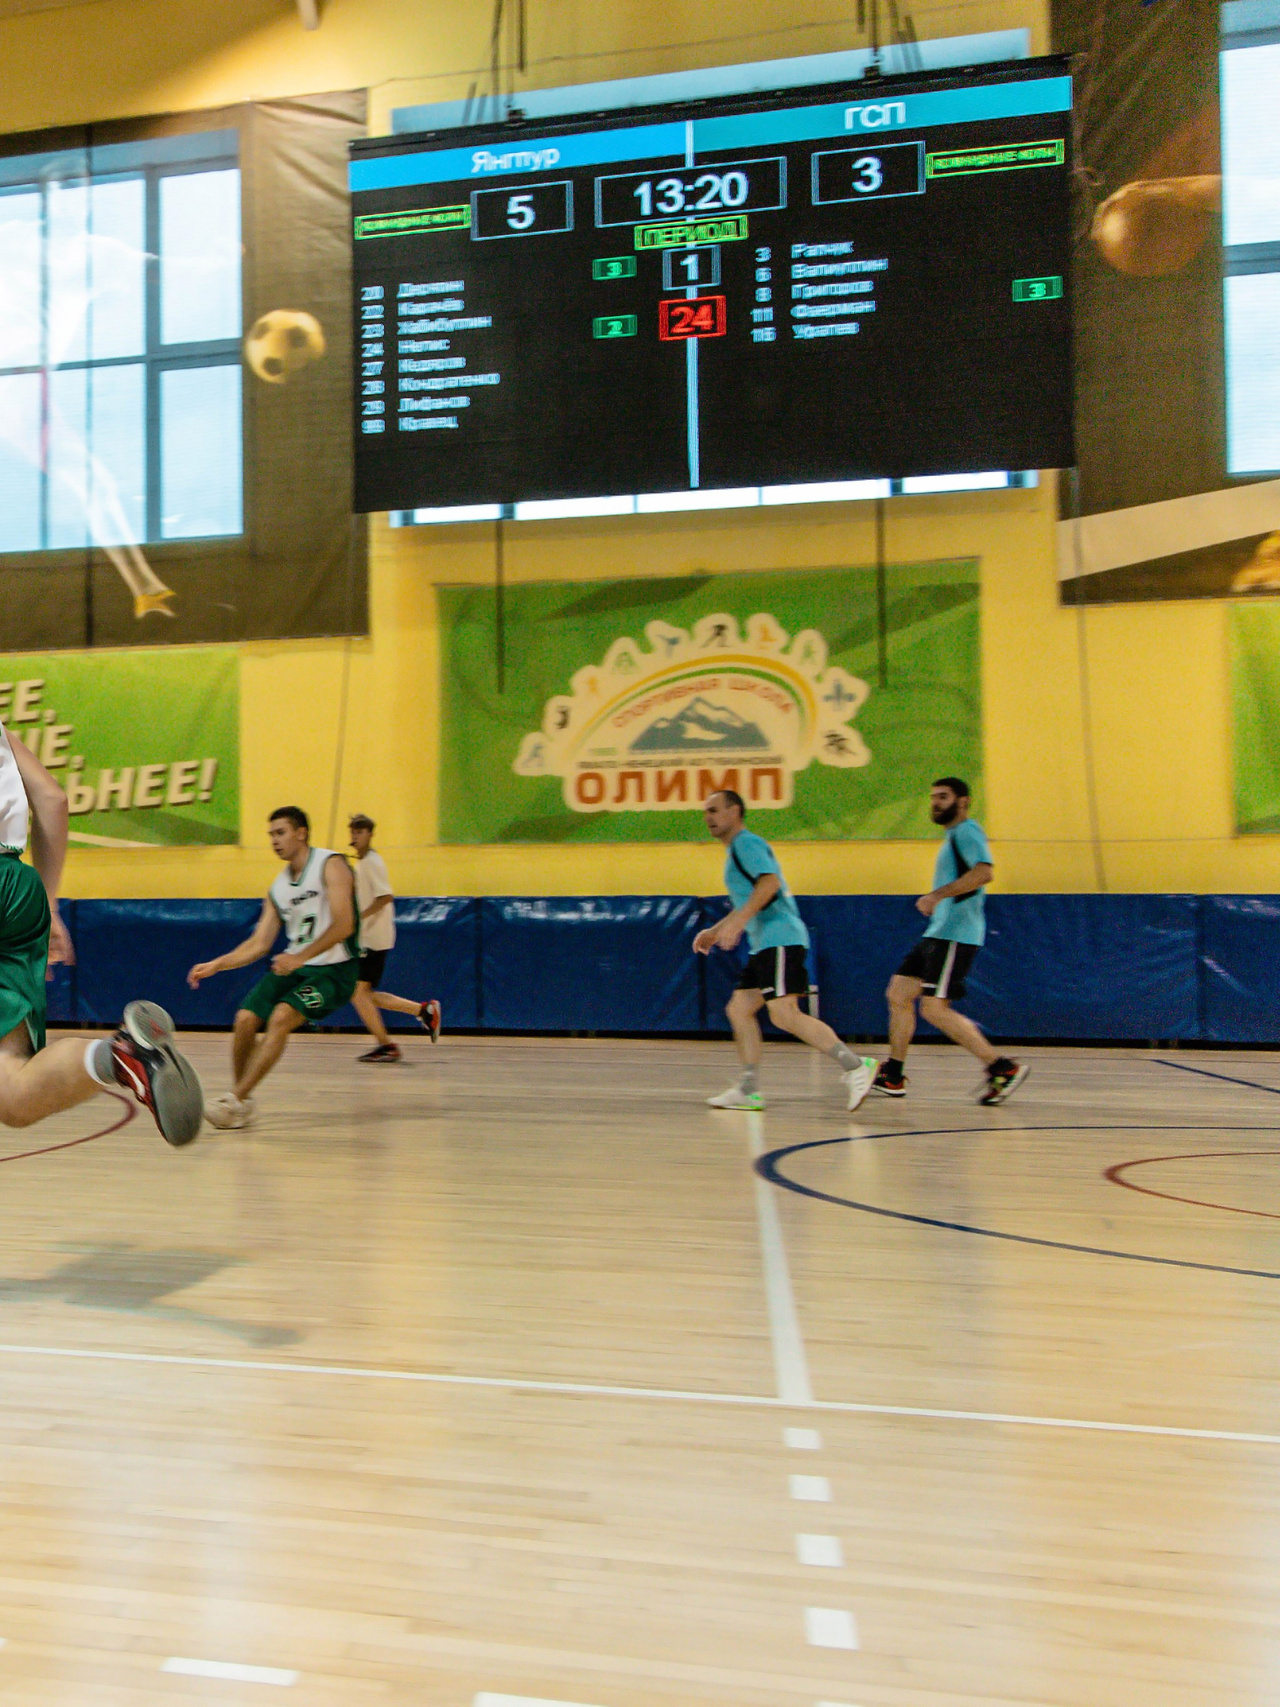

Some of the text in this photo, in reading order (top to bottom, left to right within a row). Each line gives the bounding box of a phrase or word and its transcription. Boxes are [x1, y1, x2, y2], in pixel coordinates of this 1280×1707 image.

[844, 101, 907, 130] ГСП
[851, 156, 884, 194] 3
[633, 171, 750, 217] 13:20
[506, 194, 536, 230] 5
[643, 221, 738, 246] ПЕРИОД
[679, 253, 700, 281] 1
[755, 246, 772, 263] 3
[670, 304, 715, 334] 24
[54, 758, 218, 815] ЬНЕЕ!
[574, 767, 784, 805] ОЛИМП
